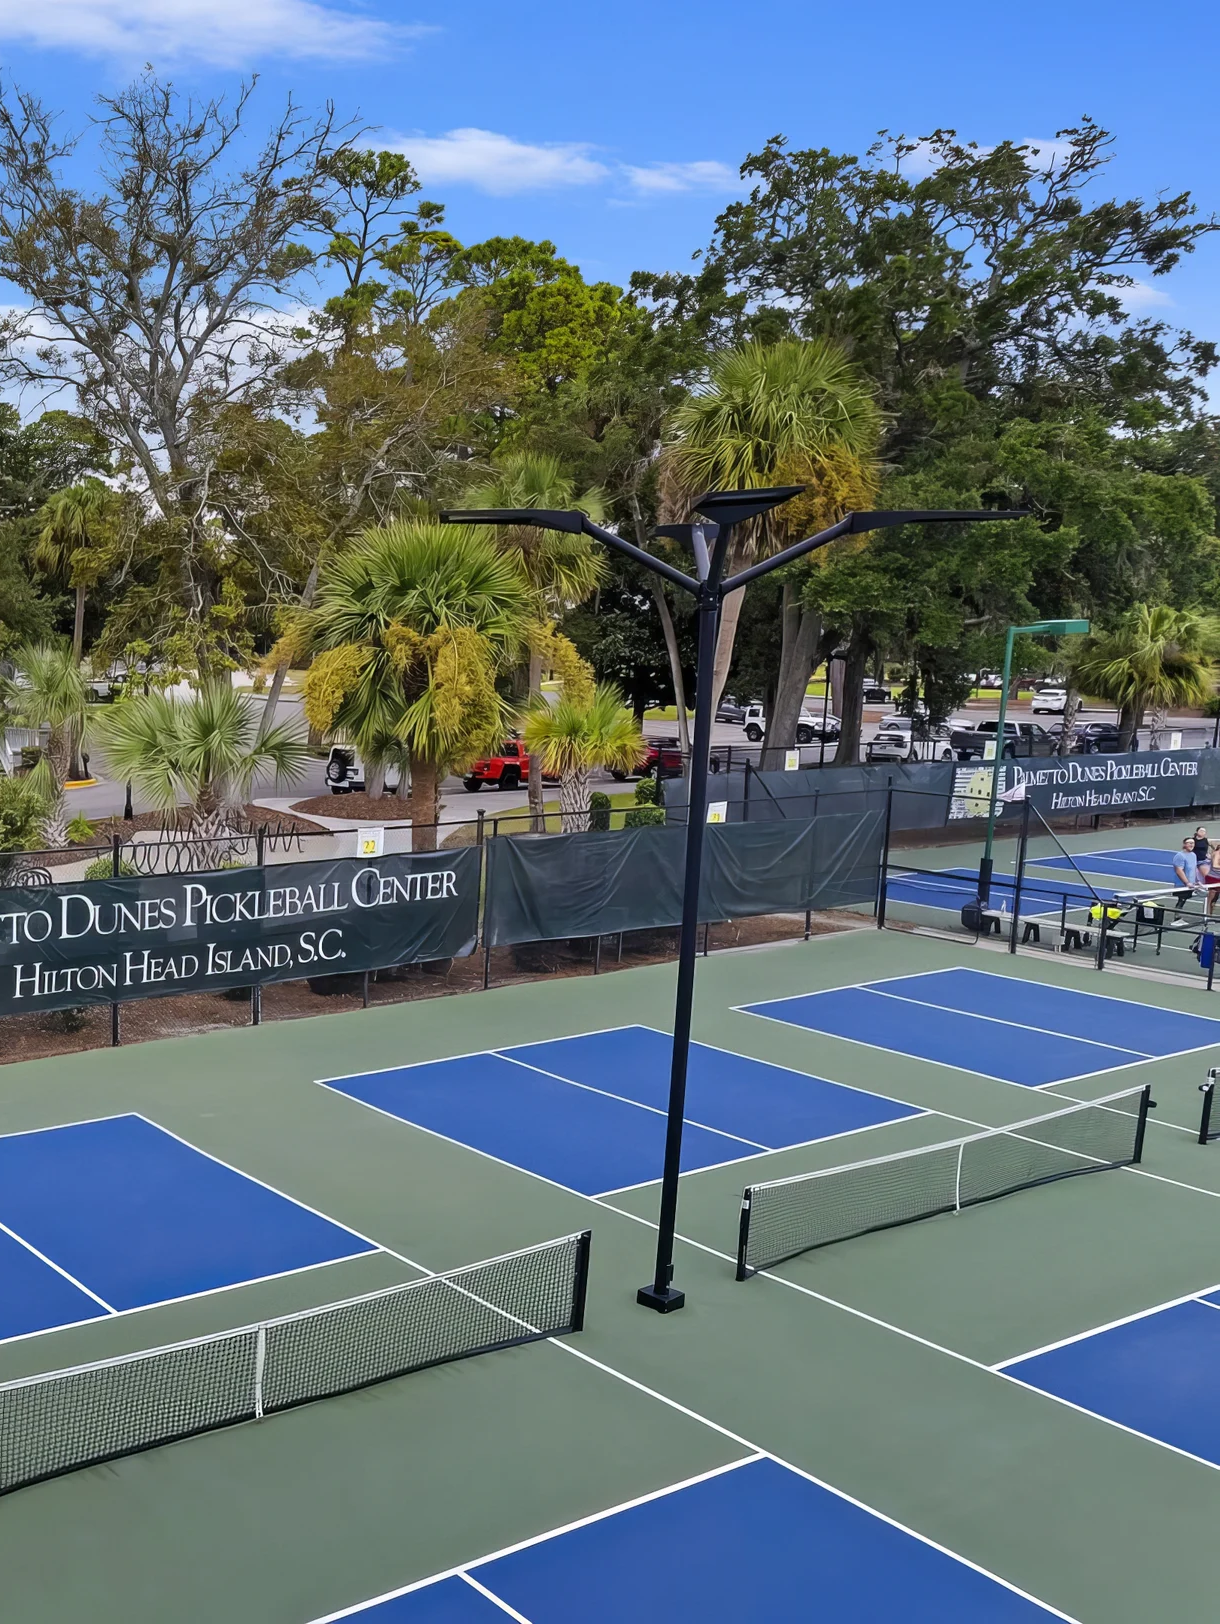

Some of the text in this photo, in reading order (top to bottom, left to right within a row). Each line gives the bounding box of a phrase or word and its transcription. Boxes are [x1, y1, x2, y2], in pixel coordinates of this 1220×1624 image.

[363, 840, 376, 854] 22
[58, 894, 177, 940] DUNES
[182, 881, 349, 927] PICKLEBALL
[351, 867, 458, 908] CENTER
[12, 929, 347, 999] HILTON HEAD ISLAND, S.C.
